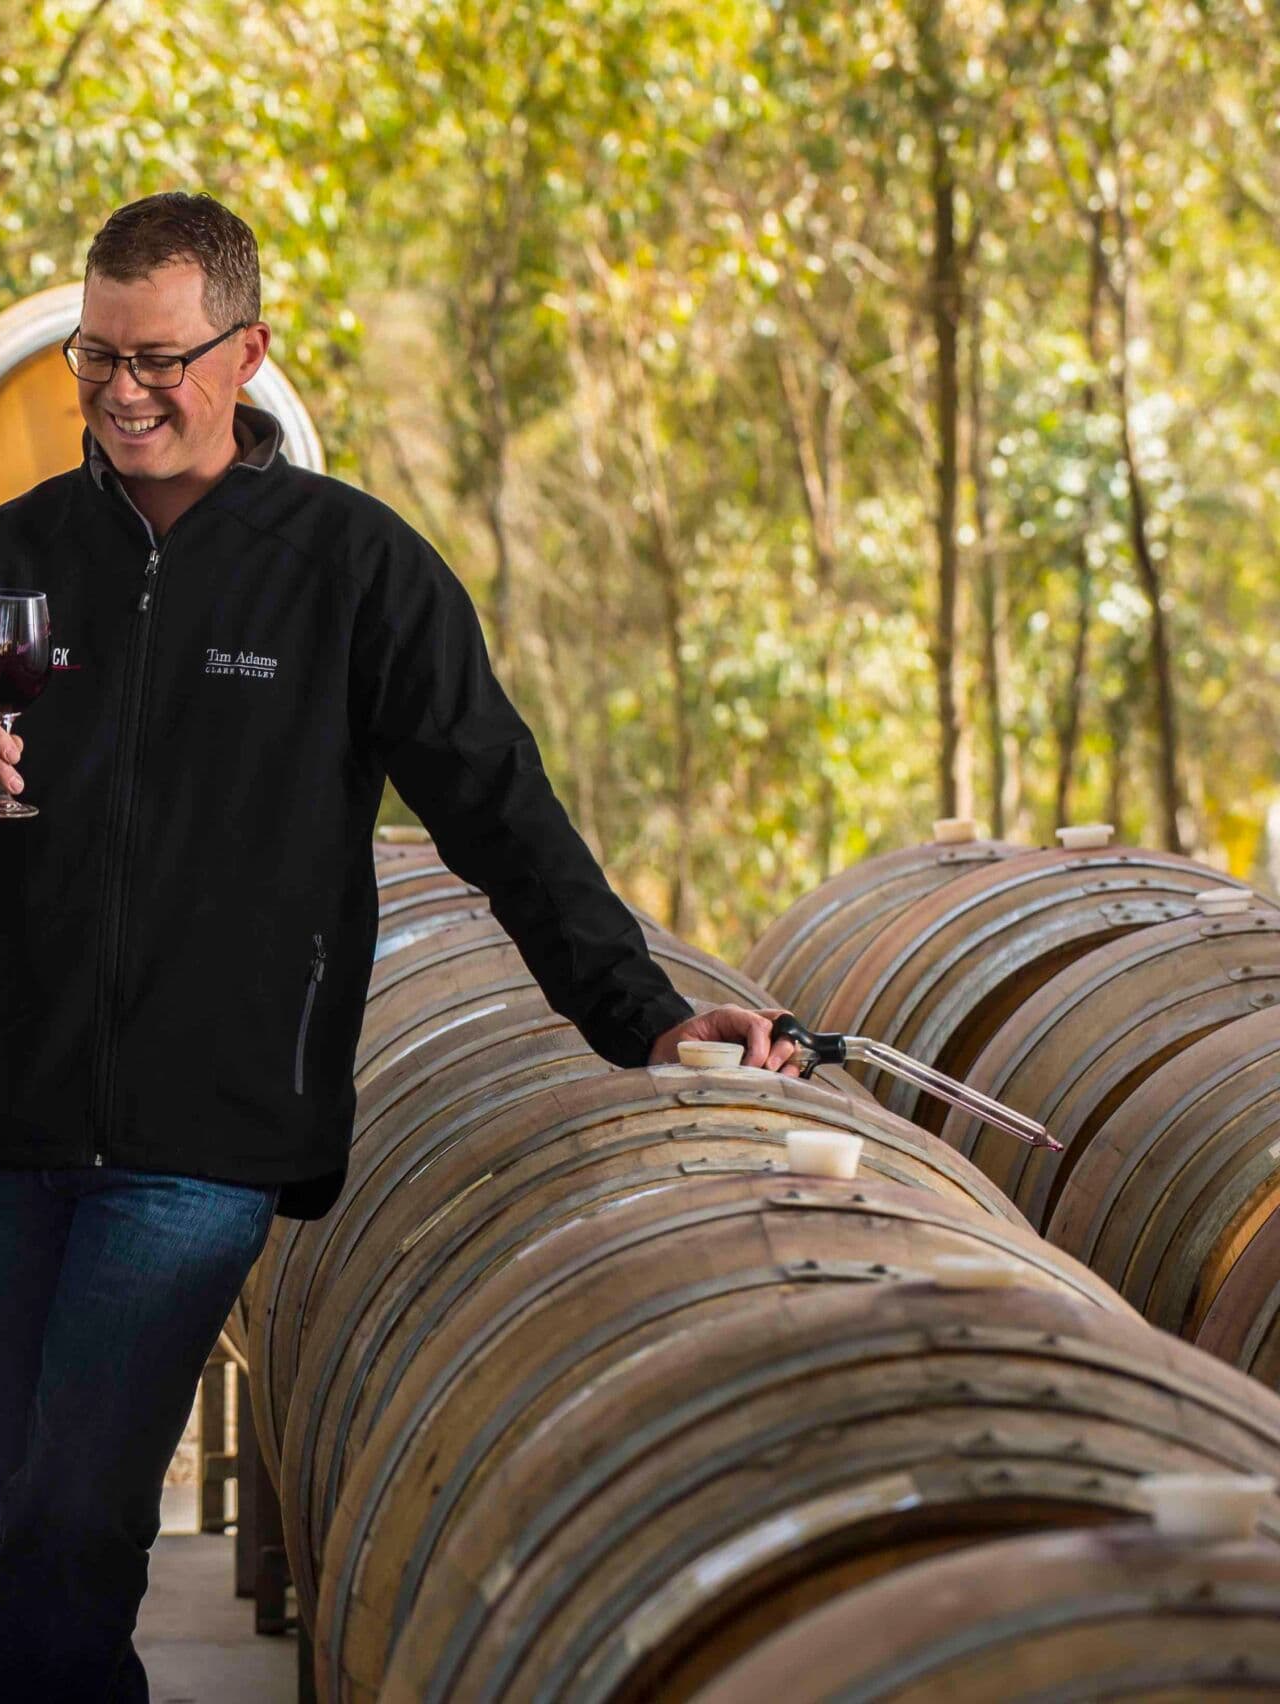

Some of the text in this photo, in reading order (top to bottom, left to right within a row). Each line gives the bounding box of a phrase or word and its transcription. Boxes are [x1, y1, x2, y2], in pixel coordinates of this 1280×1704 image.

[206, 648, 278, 667] Tim Adams
[205, 666, 275, 679] CLARE VALLEY
